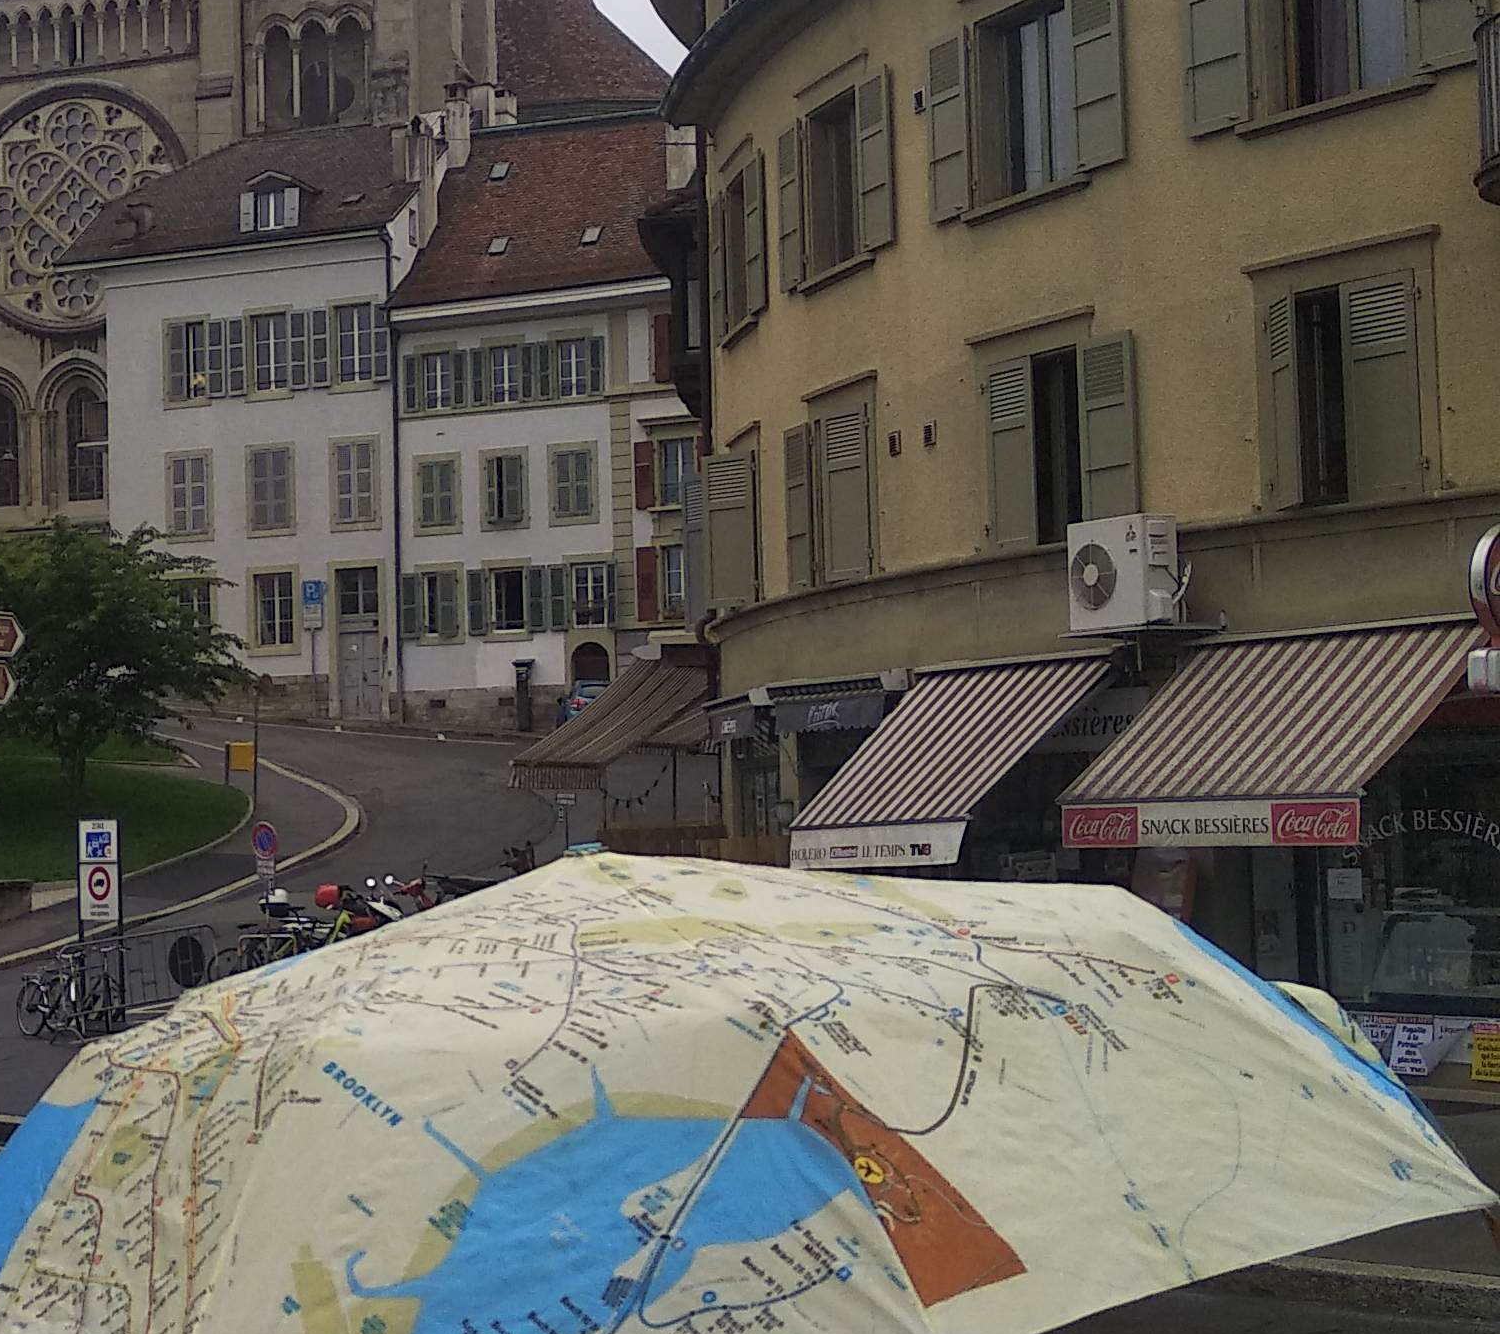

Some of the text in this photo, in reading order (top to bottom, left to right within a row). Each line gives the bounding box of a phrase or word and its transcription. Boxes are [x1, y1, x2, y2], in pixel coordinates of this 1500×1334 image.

[1141, 819, 1190, 835] SNACK
[1194, 814, 1269, 835] BESSIÈRES
[1412, 809, 1500, 851] BESSIÈR
[790, 847, 827, 862] BOLERO
[874, 844, 906, 858] TEMPS
[322, 1060, 404, 1128] BROOKLYN
